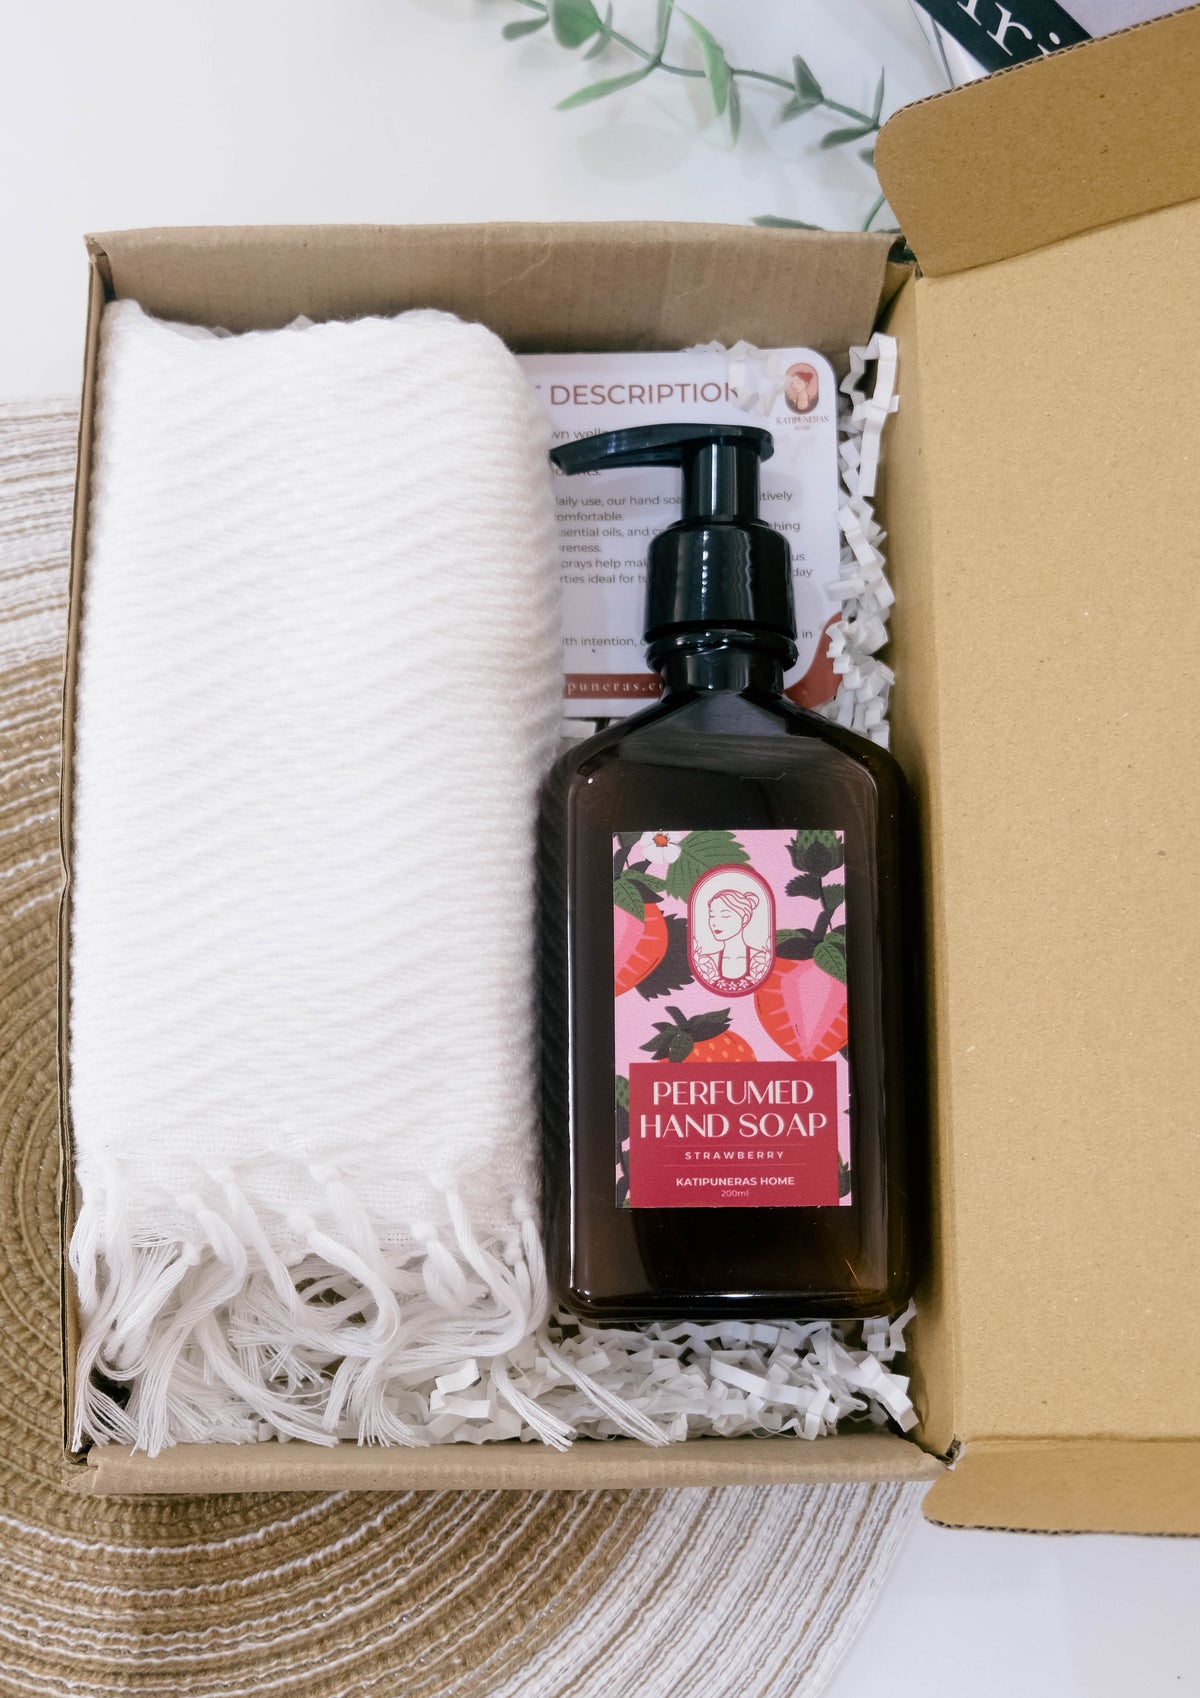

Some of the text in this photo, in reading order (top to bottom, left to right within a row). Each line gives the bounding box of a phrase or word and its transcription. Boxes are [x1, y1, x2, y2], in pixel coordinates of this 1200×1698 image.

[581, 497, 604, 507] use,
[606, 497, 626, 505] our
[629, 496, 660, 505] hand
[760, 491, 793, 502] tively
[560, 528, 599, 537] sential
[602, 527, 624, 538] oils,
[627, 526, 649, 536] and
[770, 522, 801, 532] hing
[560, 544, 602, 553] reness.
[595, 558, 621, 570] help
[588, 573, 616, 584] ideal
[619, 574, 634, 584] for
[581, 636, 637, 647] intention,
[653, 1080, 814, 1105] PERFUMED
[640, 1112, 827, 1138] HAND SOAP
[684, 1151, 785, 1160] STRAWBERRY
[675, 1176, 795, 1187] KATIPUNERAS HOME
[720, 1189, 750, 1198] 200ml
